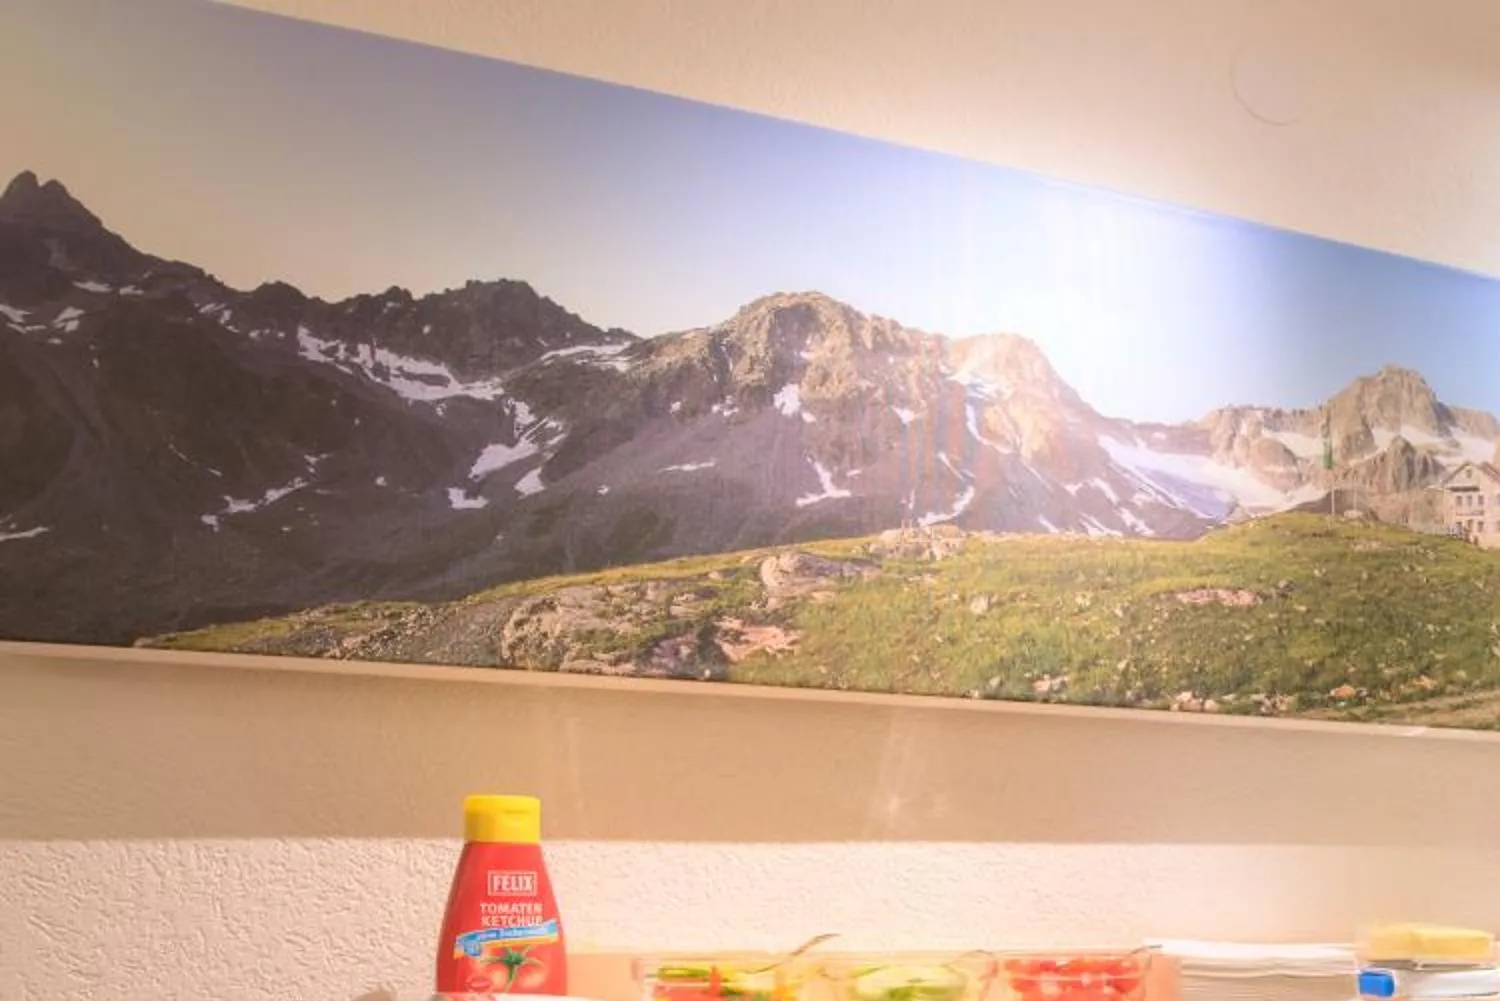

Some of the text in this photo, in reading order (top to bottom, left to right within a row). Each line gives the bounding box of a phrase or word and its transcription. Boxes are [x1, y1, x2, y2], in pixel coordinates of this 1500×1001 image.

[492, 875, 534, 891] FELIX
[480, 903, 543, 914] TOMATEN
[481, 915, 543, 928] KETCHUP
